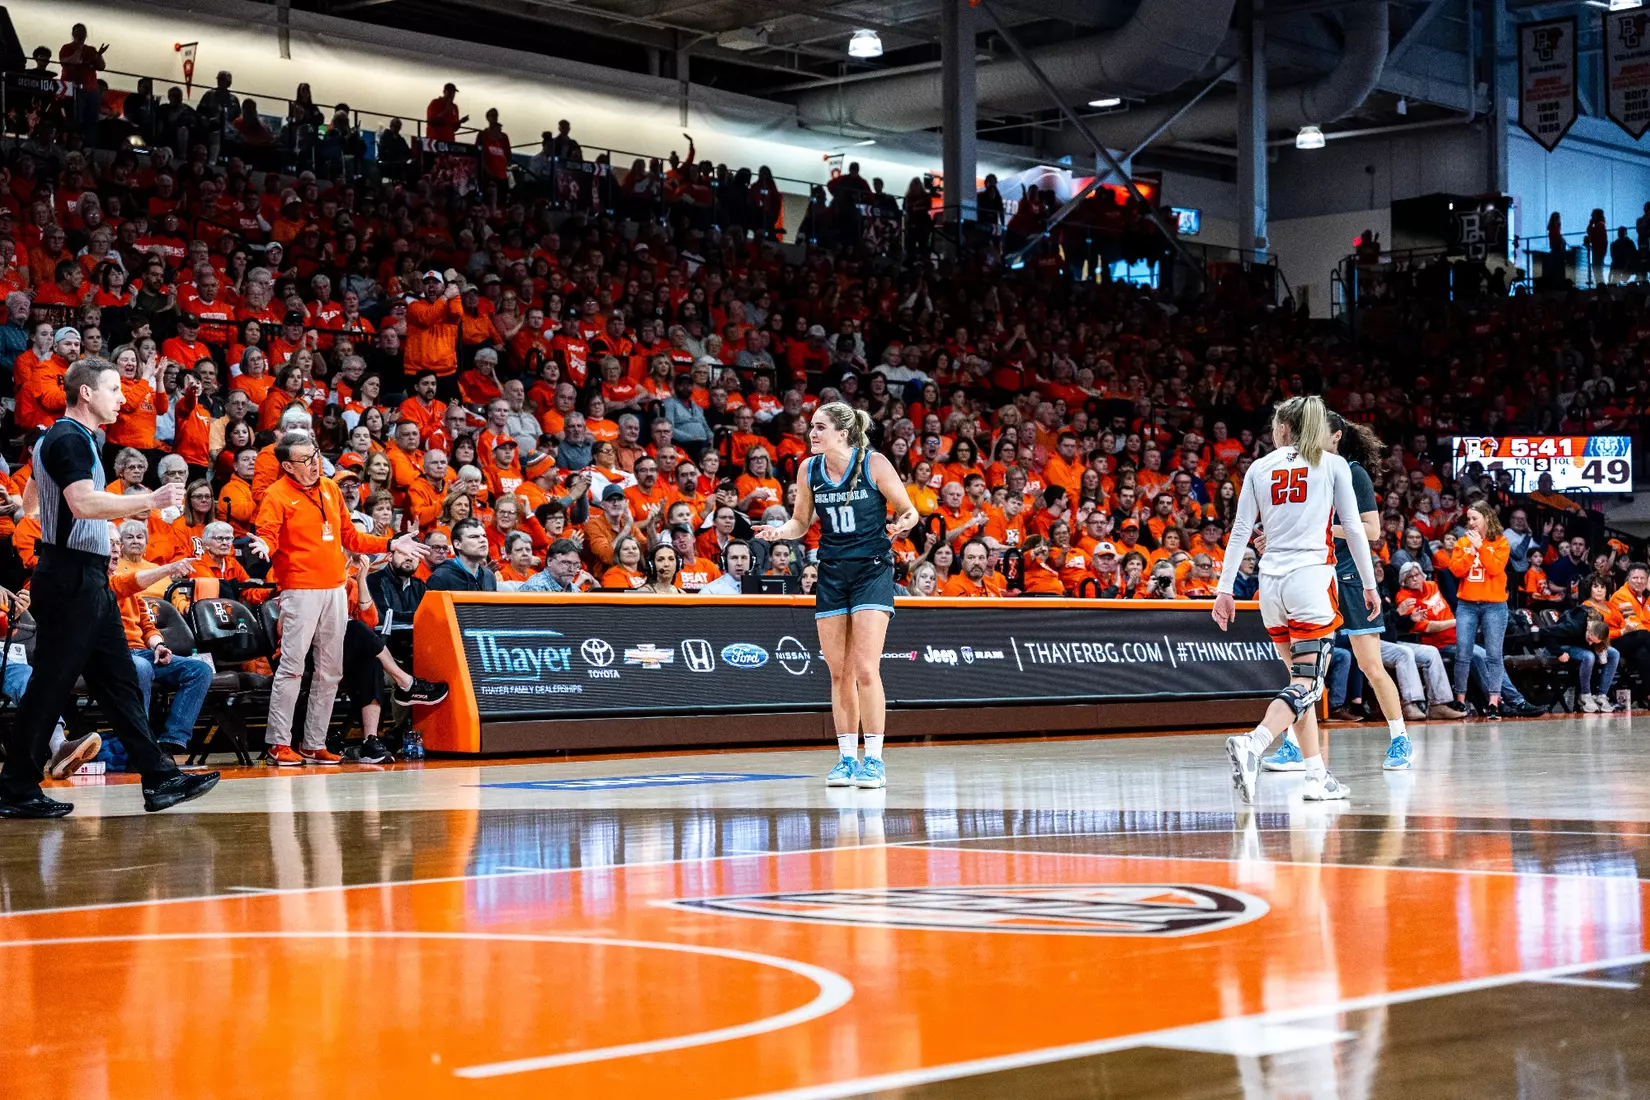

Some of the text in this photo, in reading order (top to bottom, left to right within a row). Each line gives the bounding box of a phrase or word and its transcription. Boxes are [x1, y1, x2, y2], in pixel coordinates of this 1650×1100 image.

[40, 79, 55, 92] 104
[1511, 438, 1572, 457] 5:41
[1515, 457, 1532, 466] TOL
[1535, 459, 1549, 471] 3
[1554, 457, 1571, 466] TOL
[1581, 459, 1630, 484] 49
[1271, 467, 1308, 505] 25
[826, 505, 856, 534] 10
[681, 572, 708, 583] BEAT
[464, 628, 572, 682] Thayer
[731, 648, 760, 664] Ford
[776, 651, 811, 660] NISSAN
[924, 645, 959, 665] Jeep
[975, 651, 1004, 659] RAM
[1024, 642, 1164, 664] THAYERBG.COM
[588, 669, 620, 679] TOYOTA
[481, 684, 583, 695] THAYER FAMILY DEALERSHIPS
